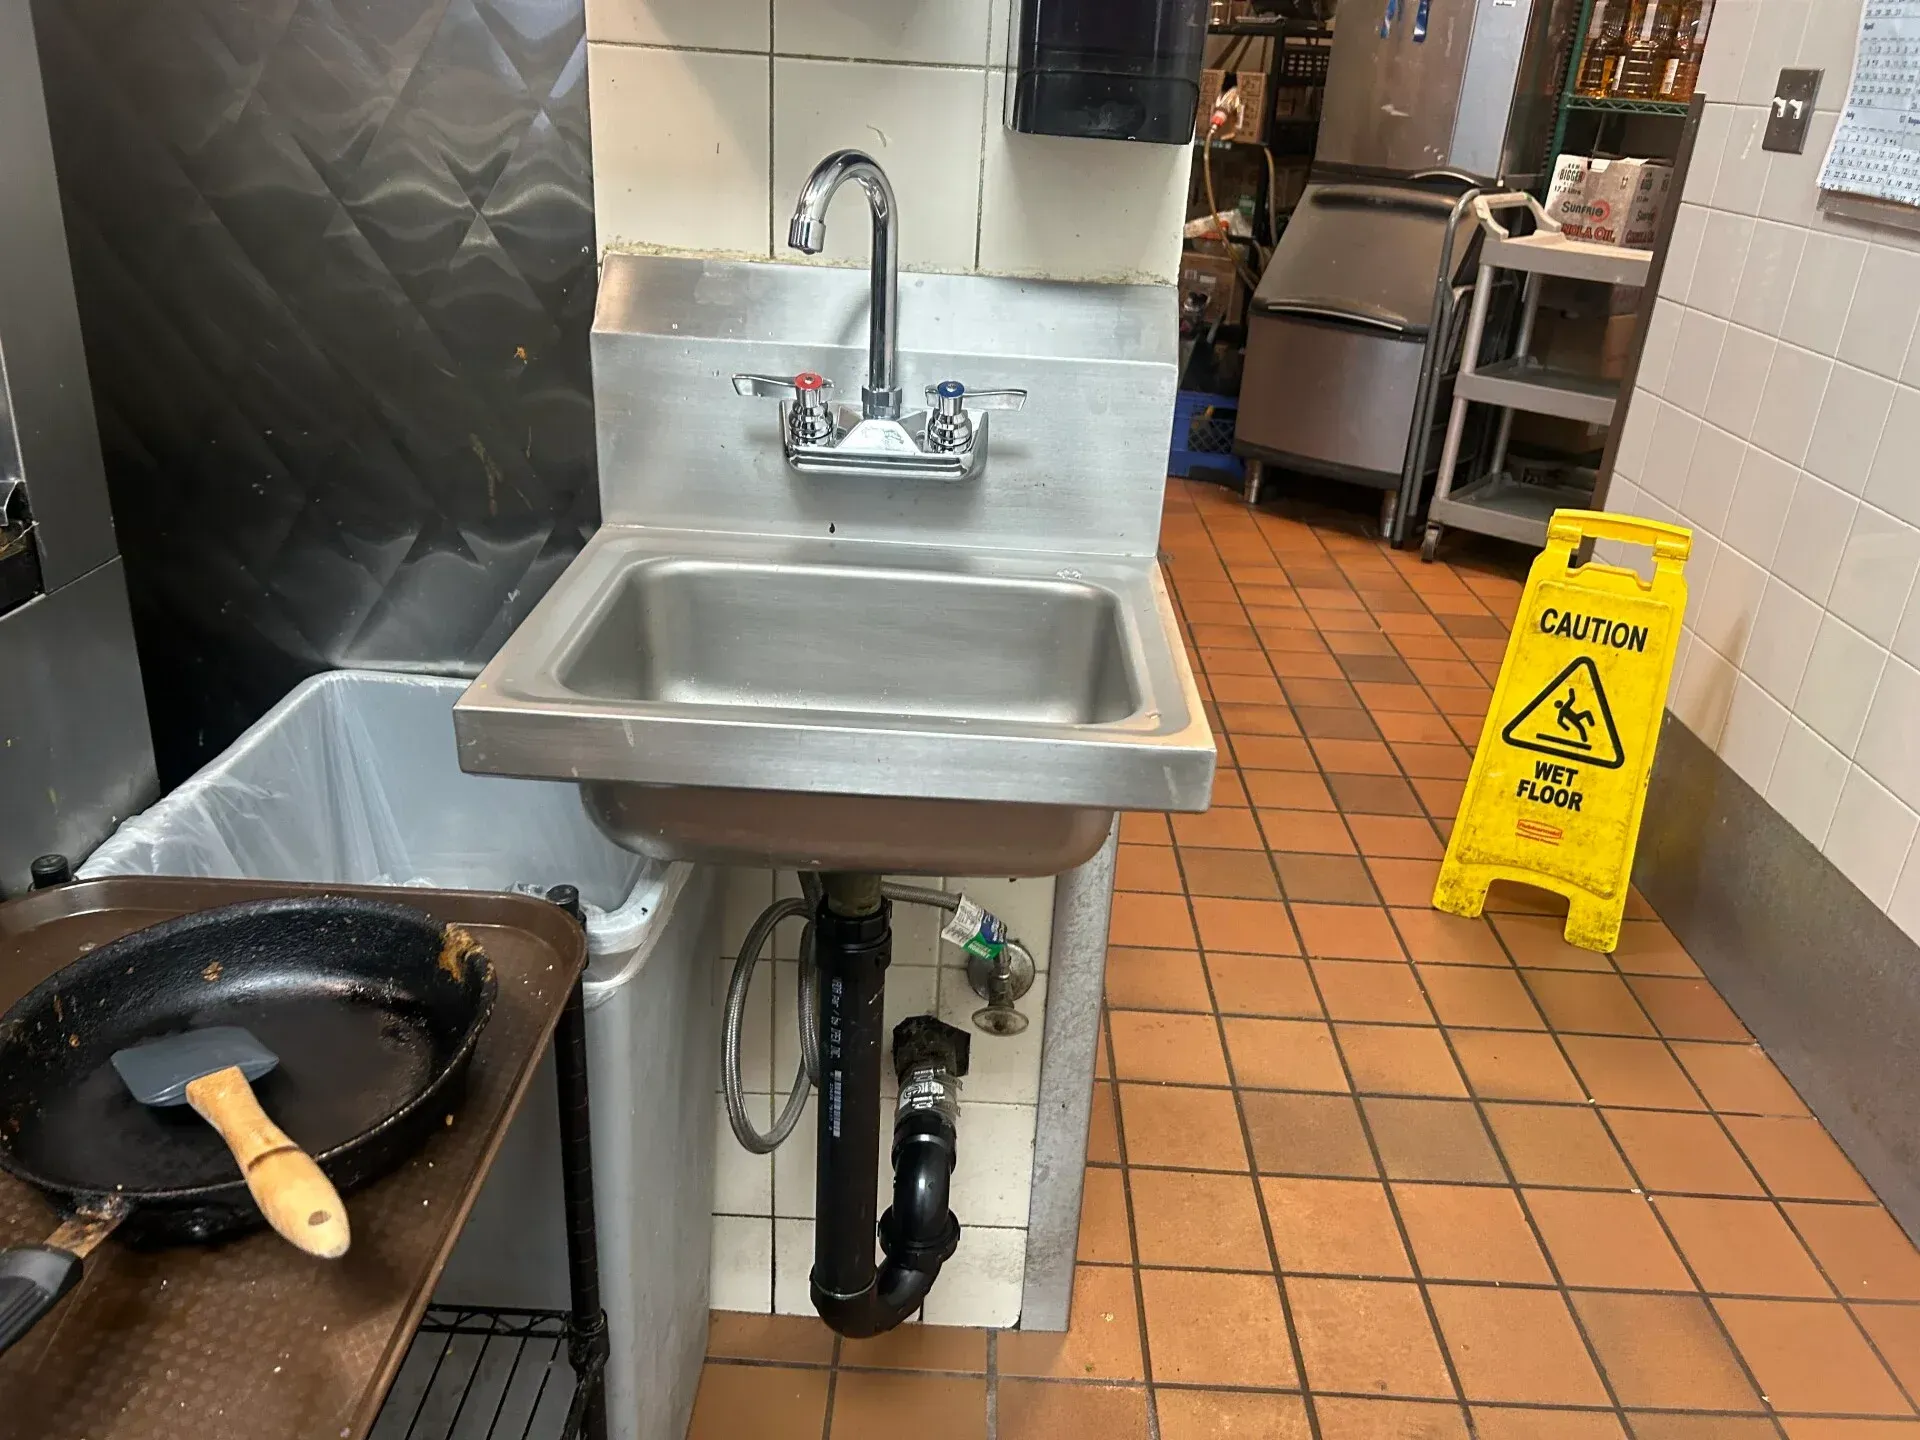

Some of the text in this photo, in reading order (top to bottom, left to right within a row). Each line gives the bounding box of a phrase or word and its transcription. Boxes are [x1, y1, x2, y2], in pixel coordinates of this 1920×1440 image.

[1846, 111, 1855, 119] July
[1559, 169, 1584, 183] BIGGER
[1540, 608, 1648, 652] CAUTION
[1534, 760, 1578, 787] WET
[1517, 779, 1583, 811] FLOOR
